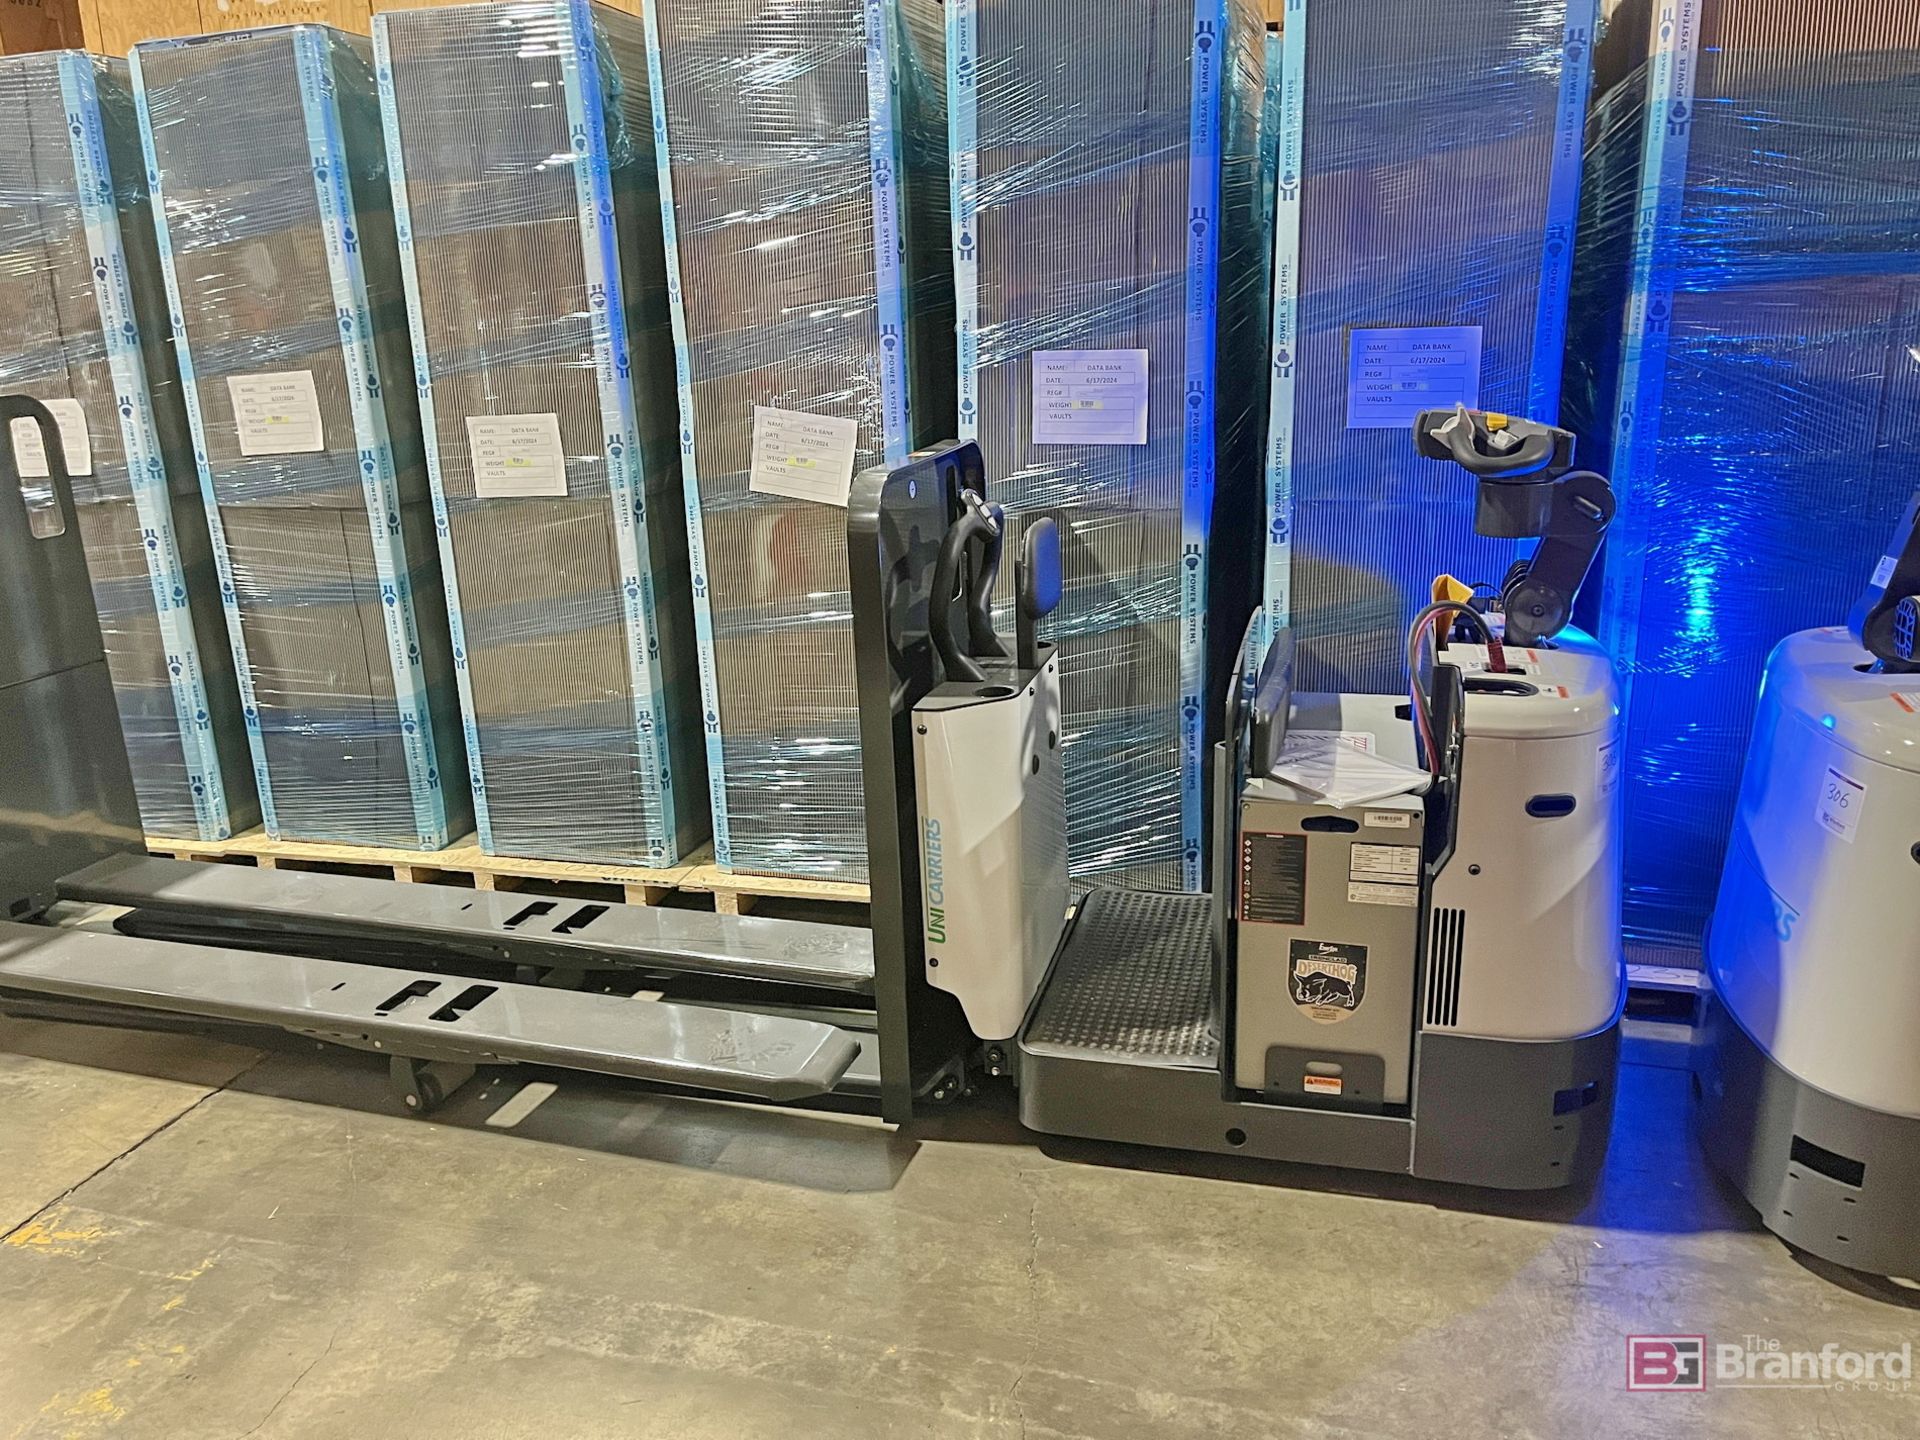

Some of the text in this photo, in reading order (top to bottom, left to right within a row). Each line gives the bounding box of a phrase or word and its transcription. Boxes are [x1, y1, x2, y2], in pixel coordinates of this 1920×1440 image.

[1677, 1, 1692, 97] POWER SYSTEMS
[1199, 57, 1210, 144] POWER SYSTEMS
[1564, 67, 1580, 159] POWER SYSTEMS
[1285, 79, 1295, 167] POWER SYSTEMS
[881, 190, 890, 269] POWER SYSTEMS
[1195, 241, 1204, 322] POWER SYSTEMS
[1550, 262, 1559, 297] POWER
[1279, 264, 1288, 346] POWER SYSTEMS
[962, 362, 970, 395] POWER
[1410, 356, 1446, 364] 6/17/2024
[888, 354, 898, 428] POWER SYSTEMS
[800, 438, 829, 448] 6/17/2024
[802, 426, 818, 434] DATA
[765, 465, 786, 474] VAULTS
[1191, 449, 1199, 489] SYSTEMS
[1274, 436, 1283, 477] SYSTEMS
[1188, 608, 1197, 645] SYSTEMS
[1188, 723, 1197, 791] POWER SYSTEMS
[1828, 783, 1850, 808] 306
[1297, 960, 1357, 983] DESERTHOG
